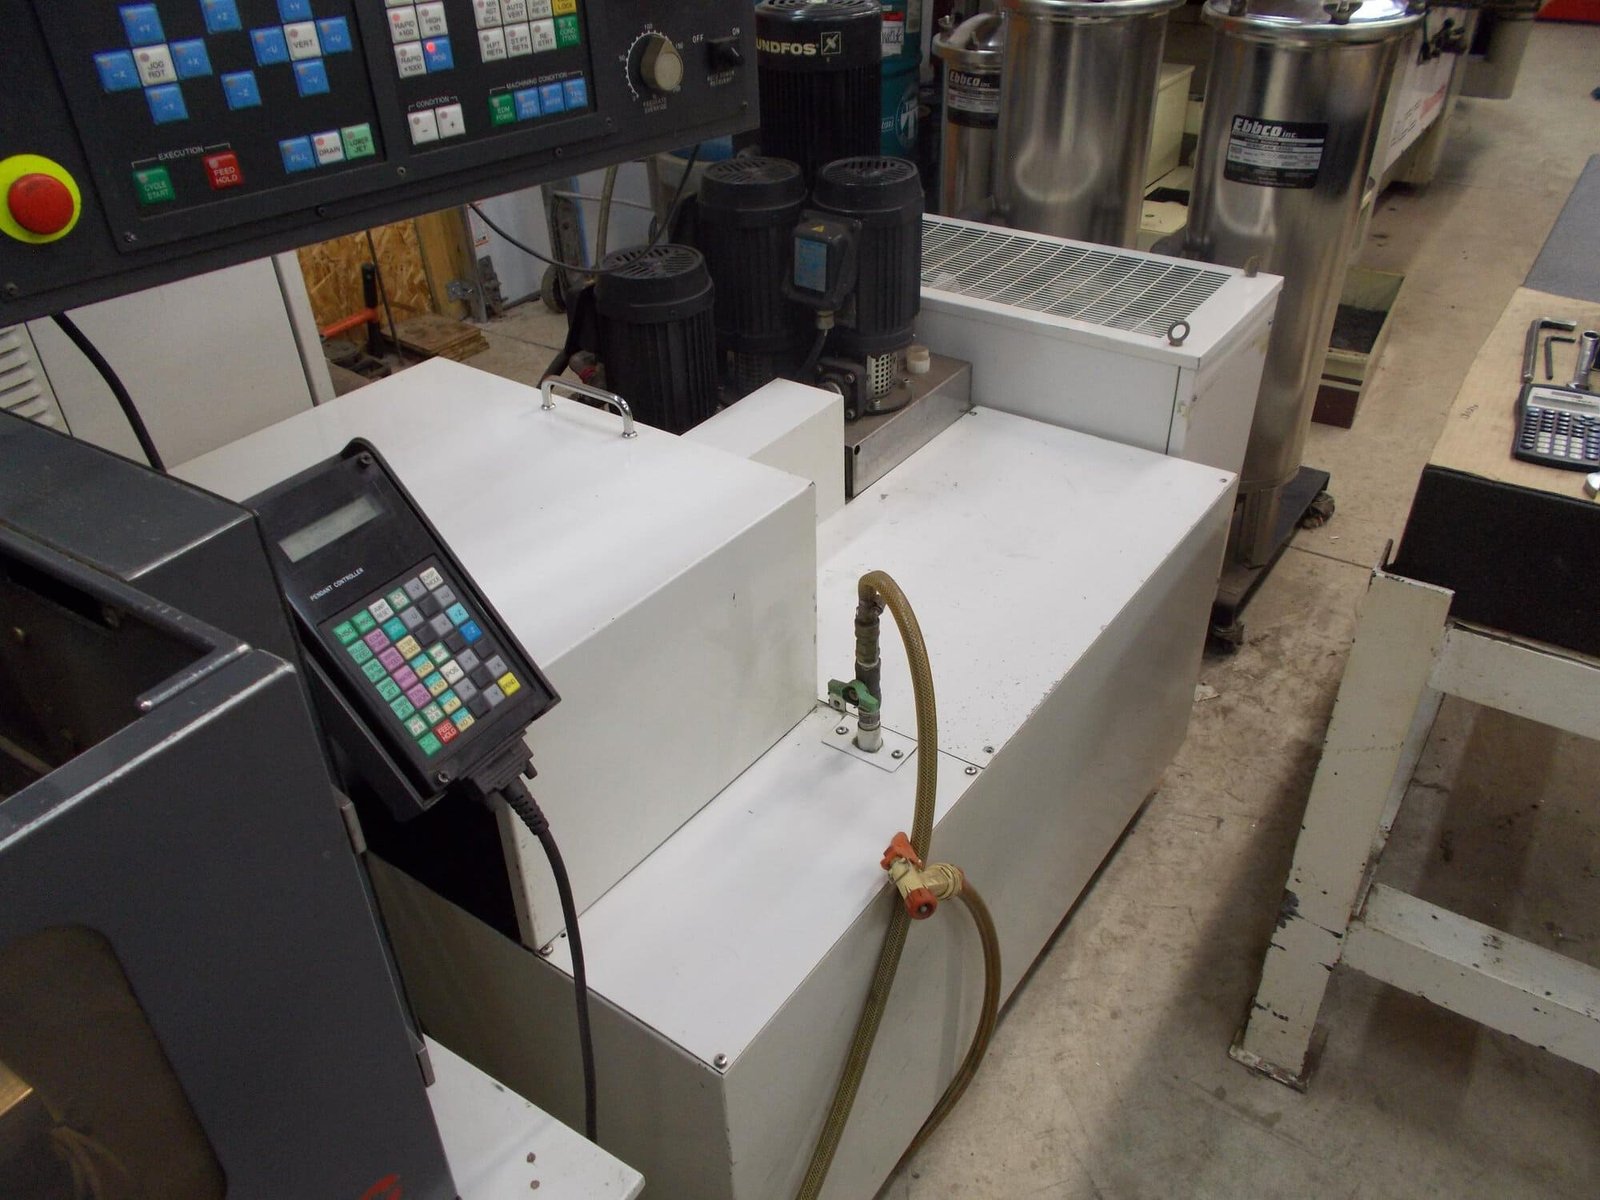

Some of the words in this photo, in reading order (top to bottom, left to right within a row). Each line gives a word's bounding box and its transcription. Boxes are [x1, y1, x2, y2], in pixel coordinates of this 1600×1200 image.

[506, 2, 524, 10] AUTO
[558, 2, 574, 10] LOCK
[394, 20, 415, 30] RAPID
[425, 16, 442, 24] HIGH
[731, 26, 740, 36] ON
[692, 34, 704, 44] OFF
[400, 54, 422, 64] RAPID
[146, 60, 164, 70] JOG
[506, 78, 538, 90] MACHINING
[538, 71, 568, 84] CONDITION
[950, 71, 982, 88] Ebbco
[415, 96, 450, 108] CONDITION
[497, 106, 510, 114] EDM
[450, 120, 456, 129] +
[1232, 117, 1284, 138] Ebbco
[158, 145, 204, 161] EXECUTION
[318, 147, 342, 157] DRAIN
[354, 146, 368, 154] JET
[213, 166, 236, 177] FEED
[215, 174, 238, 186] HOLD
[144, 180, 168, 192] CYCLE
[146, 188, 169, 201] START
[310, 584, 334, 602] PENDANT
[333, 567, 364, 588] CONTROLLER
[444, 665, 460, 678] POS
[436, 721, 453, 736] FEED
[439, 726, 458, 741] HOLD
